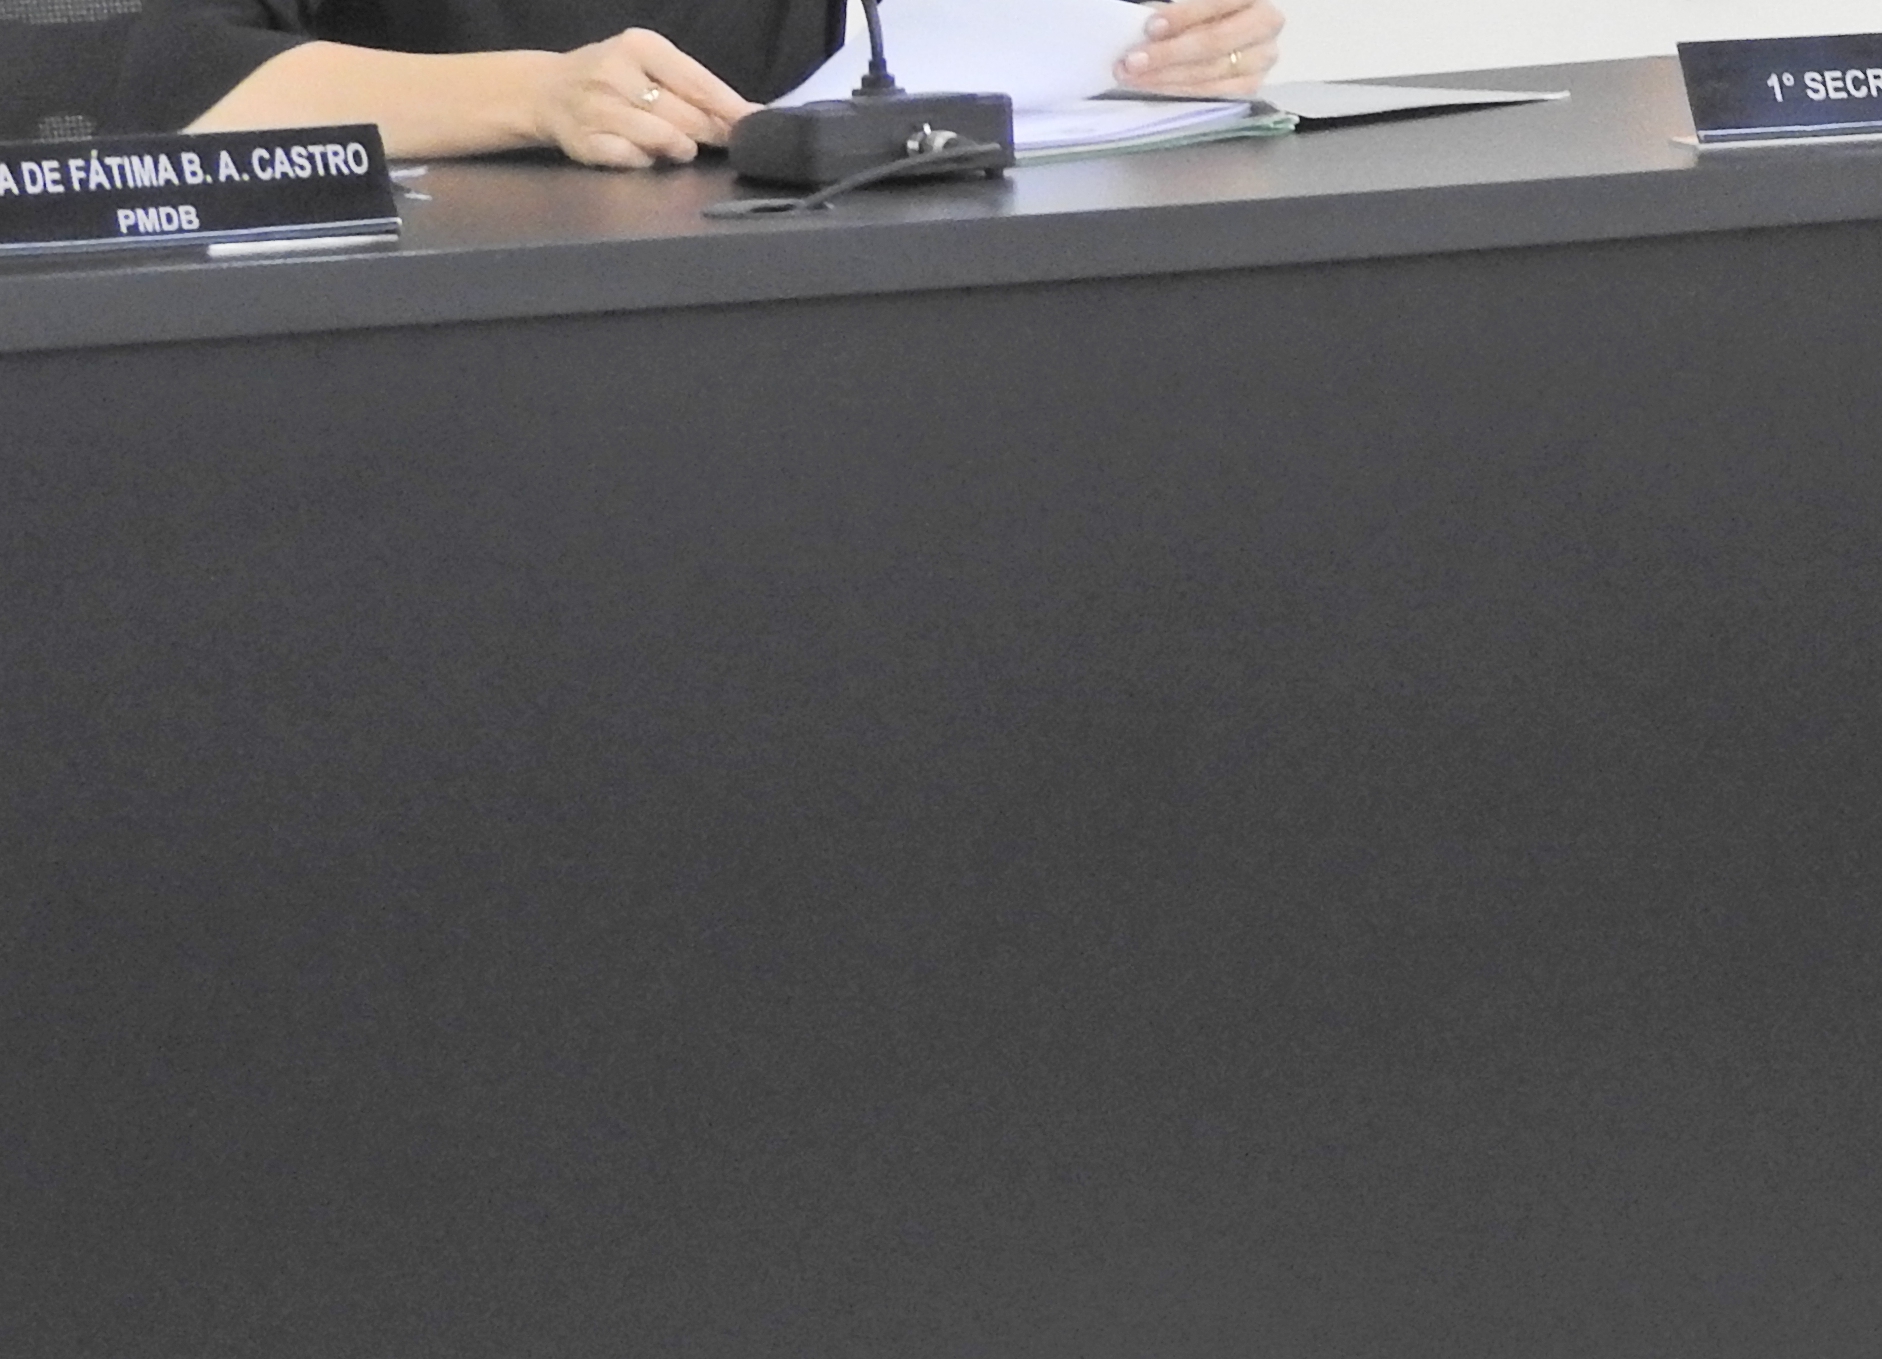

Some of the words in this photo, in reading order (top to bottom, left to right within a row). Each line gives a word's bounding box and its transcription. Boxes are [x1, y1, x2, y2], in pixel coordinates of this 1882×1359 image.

[1766, 72, 1796, 103] 1º
[21, 160, 65, 195] DE
[68, 149, 179, 192] FÁTIMA
[181, 151, 213, 185] B.
[219, 150, 250, 183] A.
[252, 142, 369, 181] CASTRO
[117, 204, 200, 234] PMDB
